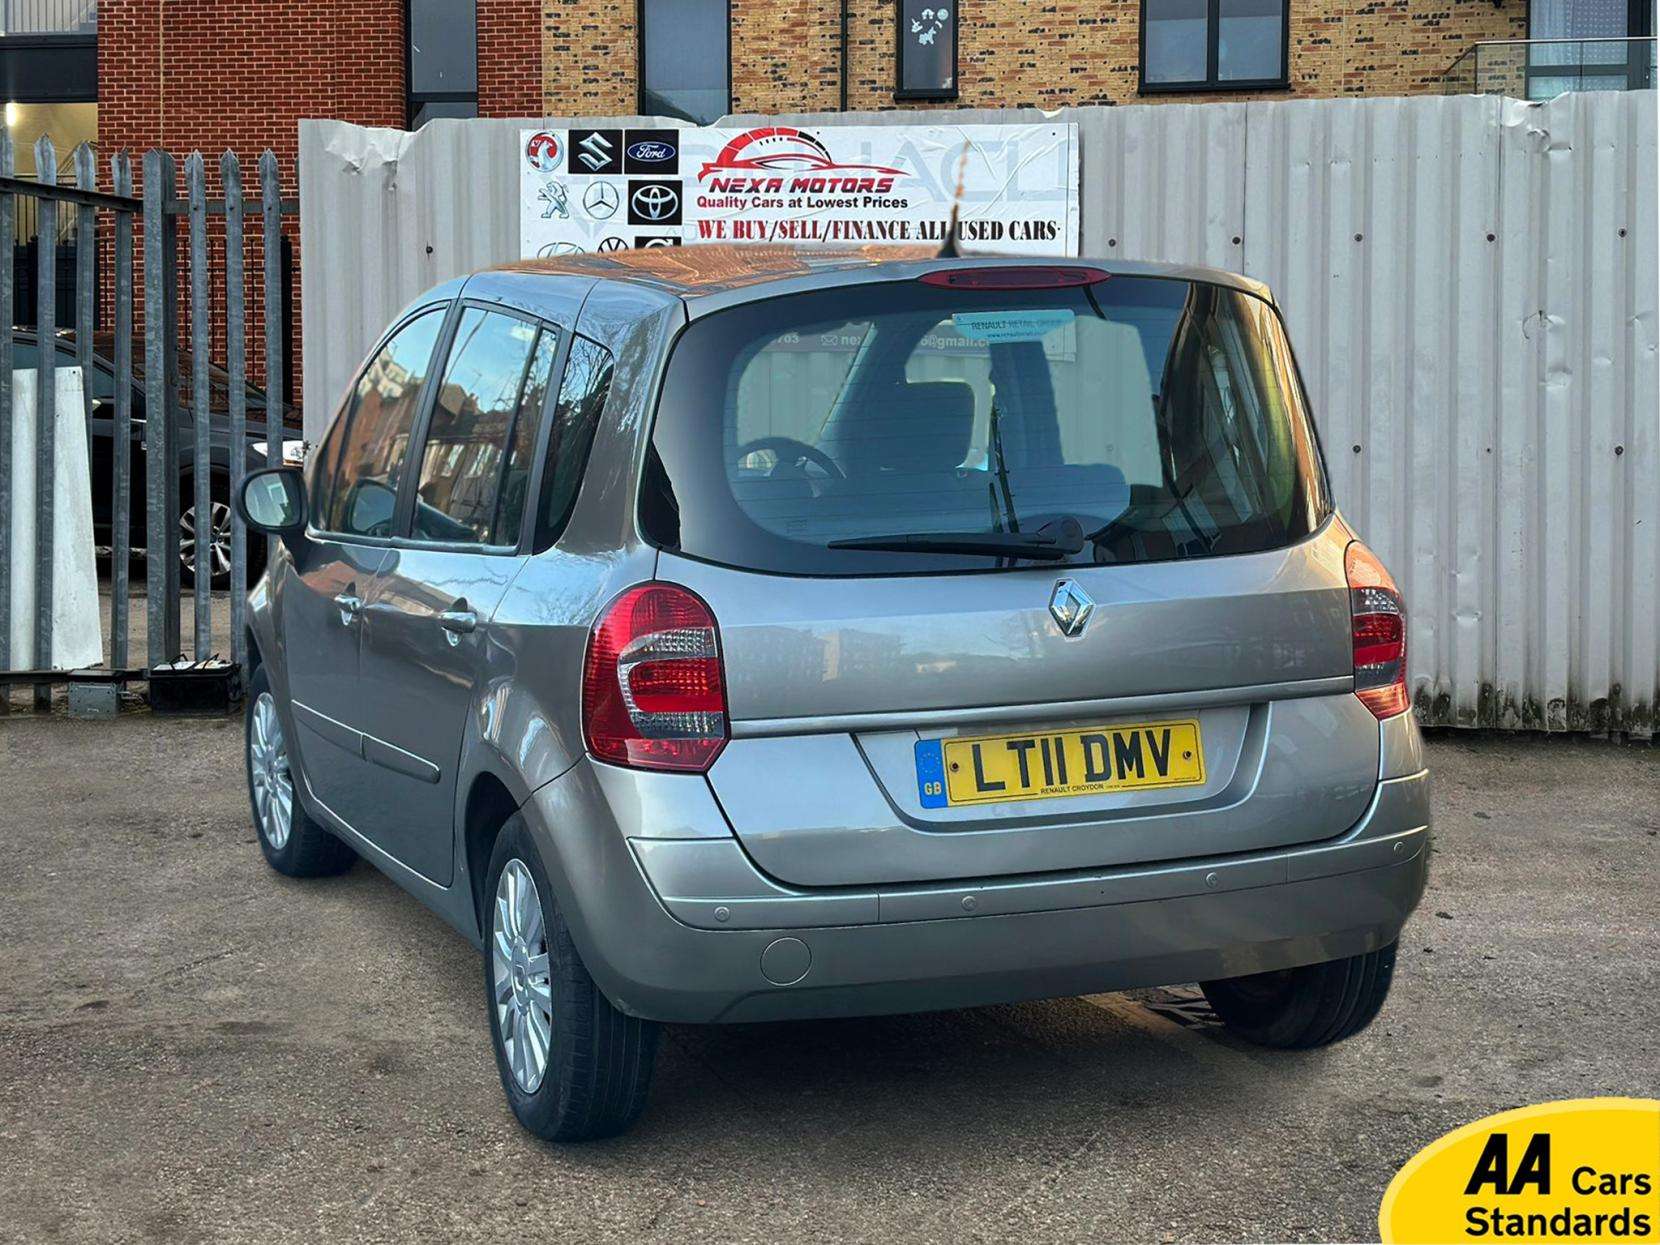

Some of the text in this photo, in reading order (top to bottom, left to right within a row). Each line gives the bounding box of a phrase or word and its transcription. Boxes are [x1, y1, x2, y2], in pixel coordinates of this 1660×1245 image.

[636, 144, 666, 159] Ford
[709, 177, 894, 194] NEXA MOTORS
[697, 196, 908, 210] Quality Cars at Lowest Prices
[697, 219, 726, 240] WE
[957, 220, 1004, 241] USED
[1008, 220, 1057, 241] CARS
[972, 729, 1171, 793] LT11 DMV
[924, 782, 942, 796] GB
[1040, 785, 1070, 794] RENAULT
[1072, 783, 1104, 792] CROYDON
